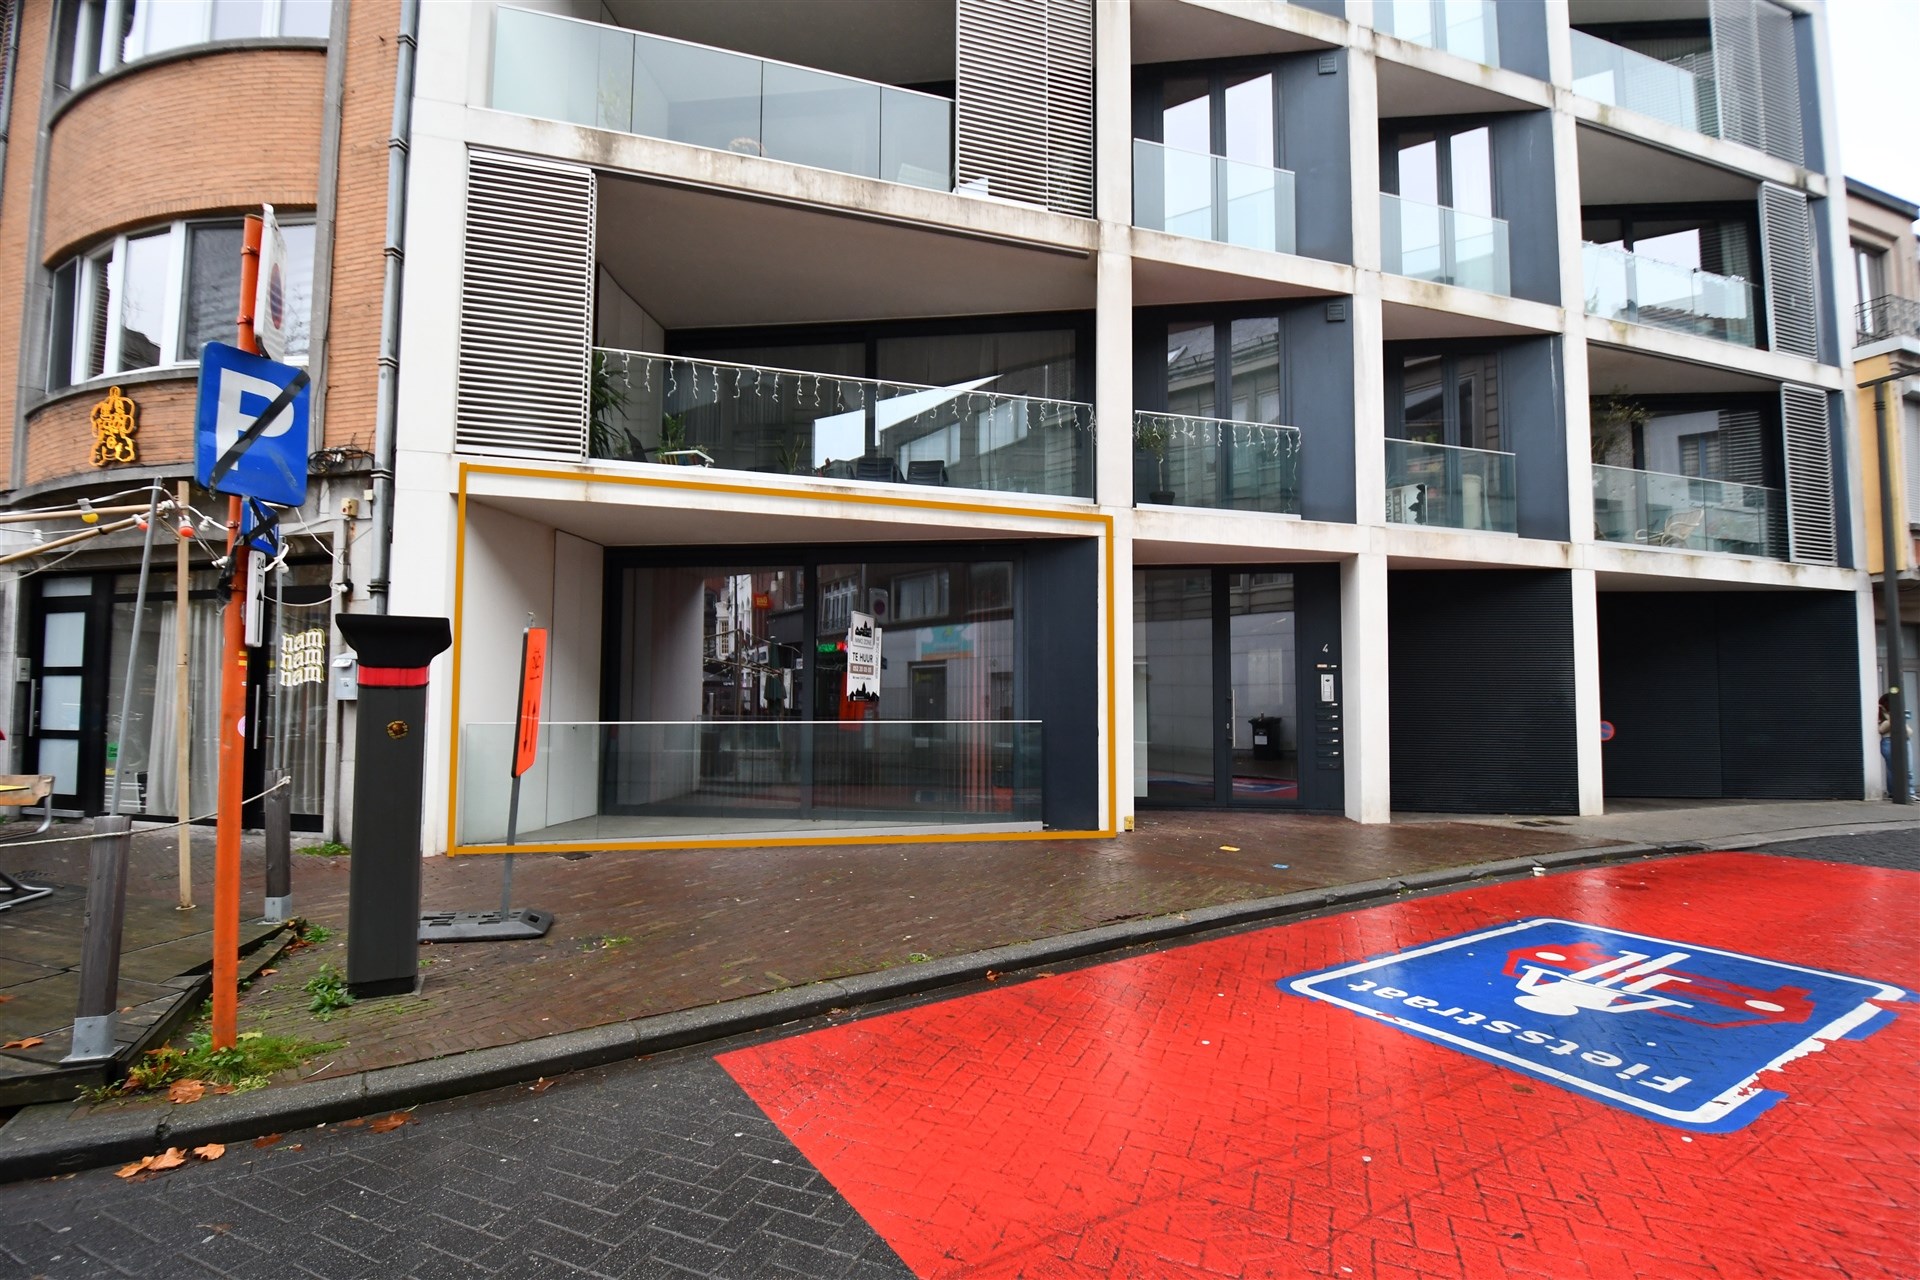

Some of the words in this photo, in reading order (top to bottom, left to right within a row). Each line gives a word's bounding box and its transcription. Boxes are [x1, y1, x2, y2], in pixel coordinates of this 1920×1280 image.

[216, 367, 295, 472] P
[859, 653, 873, 663] HUUR
[1322, 643, 1329, 653] 4
[1347, 979, 1693, 1093] Fietsstraat
